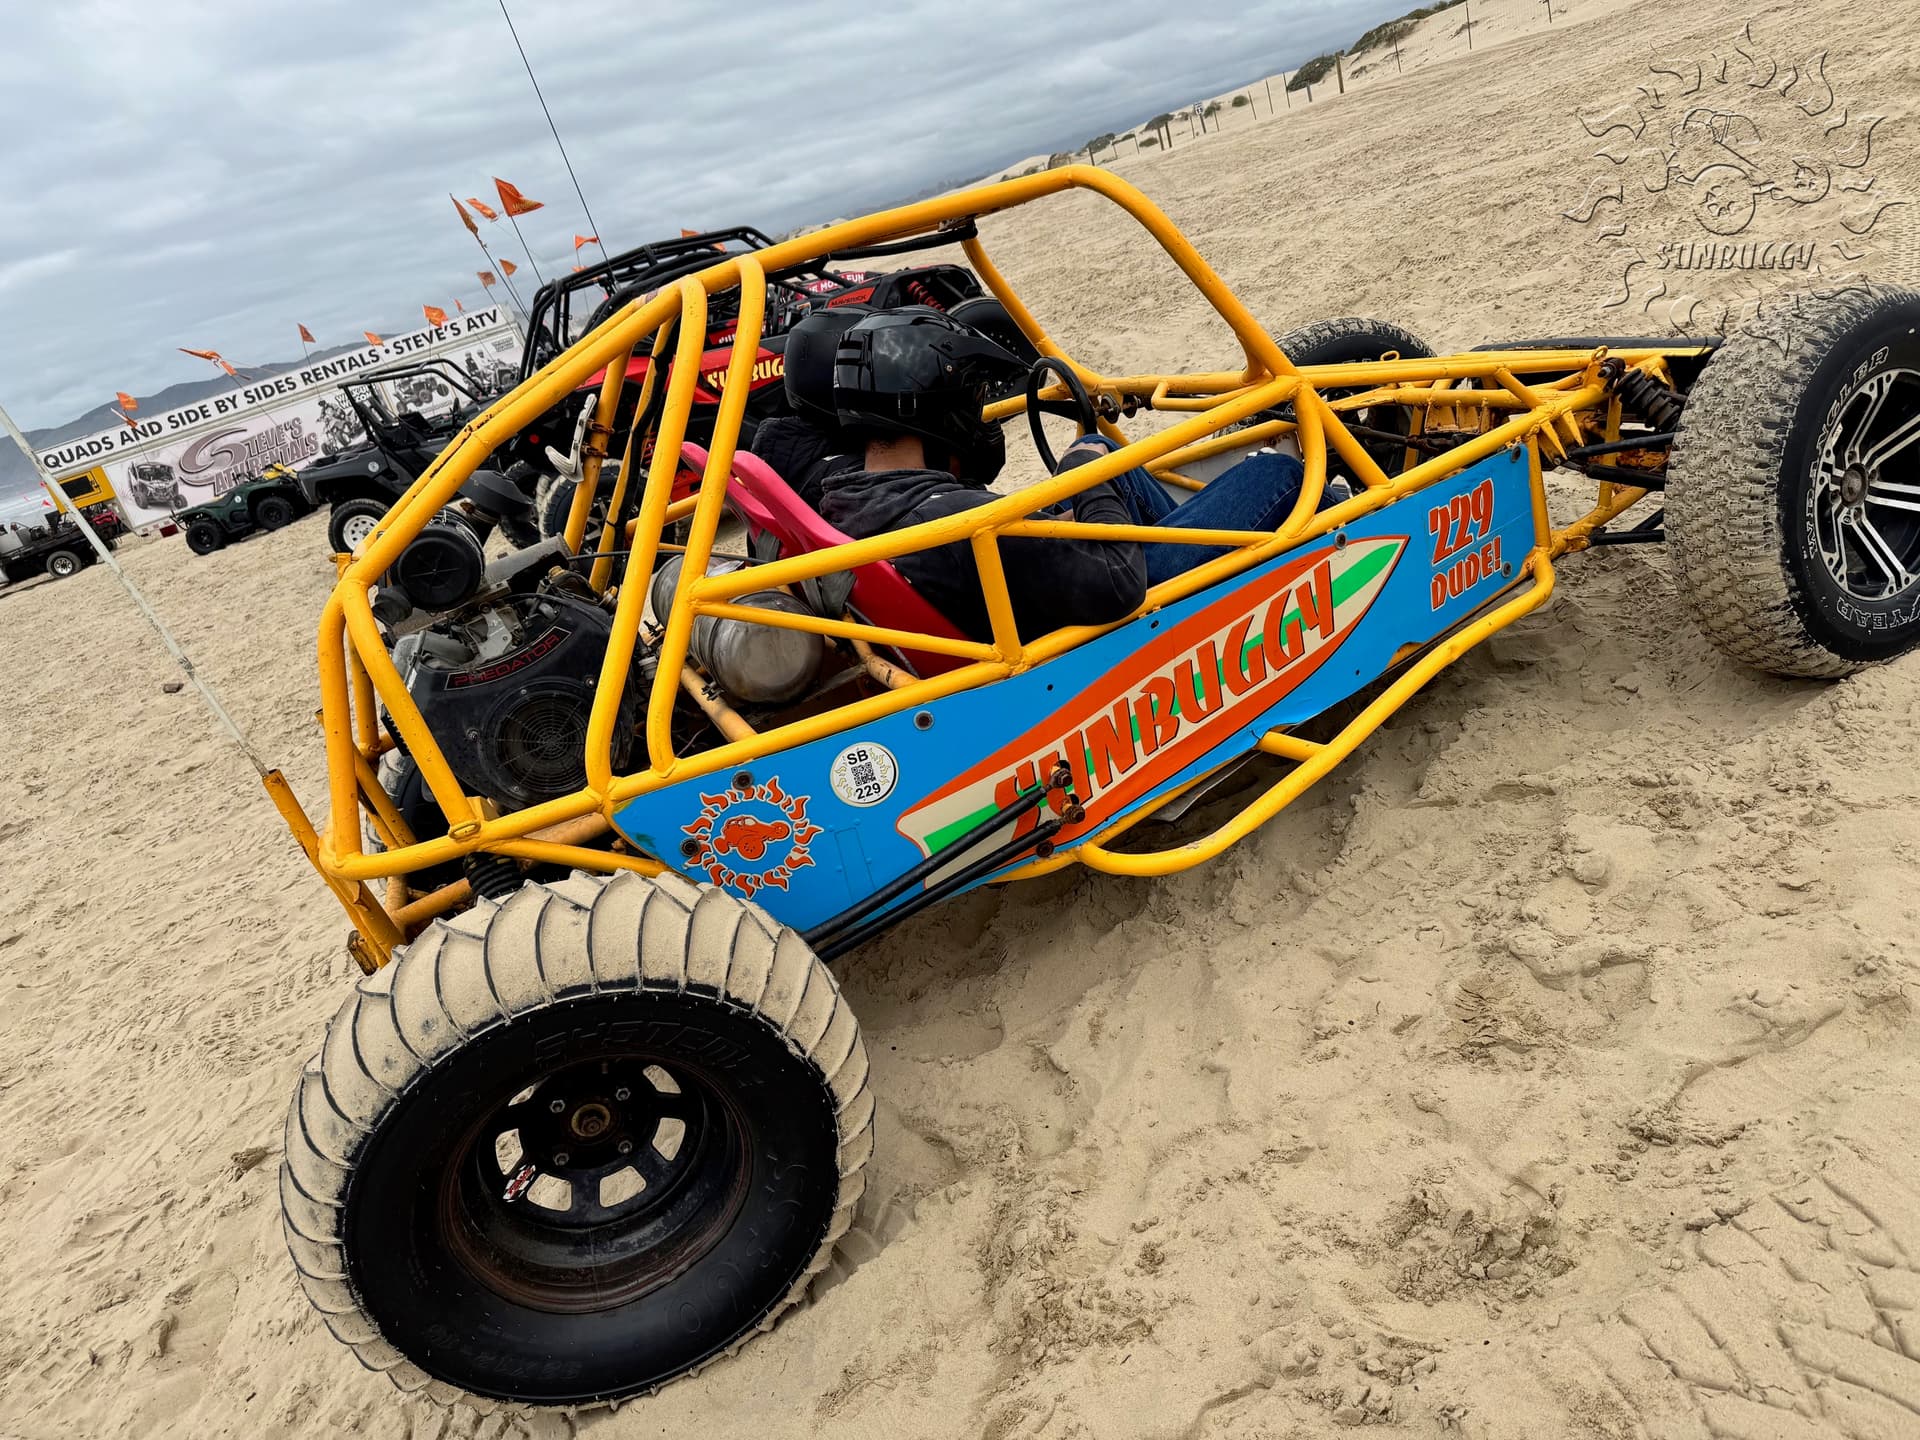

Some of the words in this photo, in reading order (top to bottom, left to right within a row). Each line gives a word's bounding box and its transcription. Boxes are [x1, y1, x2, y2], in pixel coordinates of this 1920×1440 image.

[43, 436, 114, 469] QUADS
[120, 421, 162, 446] AND
[167, 404, 211, 429] SIDE
[214, 394, 239, 414] BY
[243, 379, 297, 405] SIDES
[300, 349, 380, 386] RENTALS
[393, 322, 461, 355] STEVE'S
[466, 309, 498, 332] ATV
[707, 357, 784, 388] SUBUG
[248, 432, 319, 480] RENTALS
[1428, 478, 1494, 566] 229
[1430, 535, 1501, 612] DUDE!
[454, 633, 561, 687] PREDATOR
[995, 560, 1335, 848] SUNBUGGY
[846, 749, 869, 765] SB
[855, 782, 881, 799] 229
